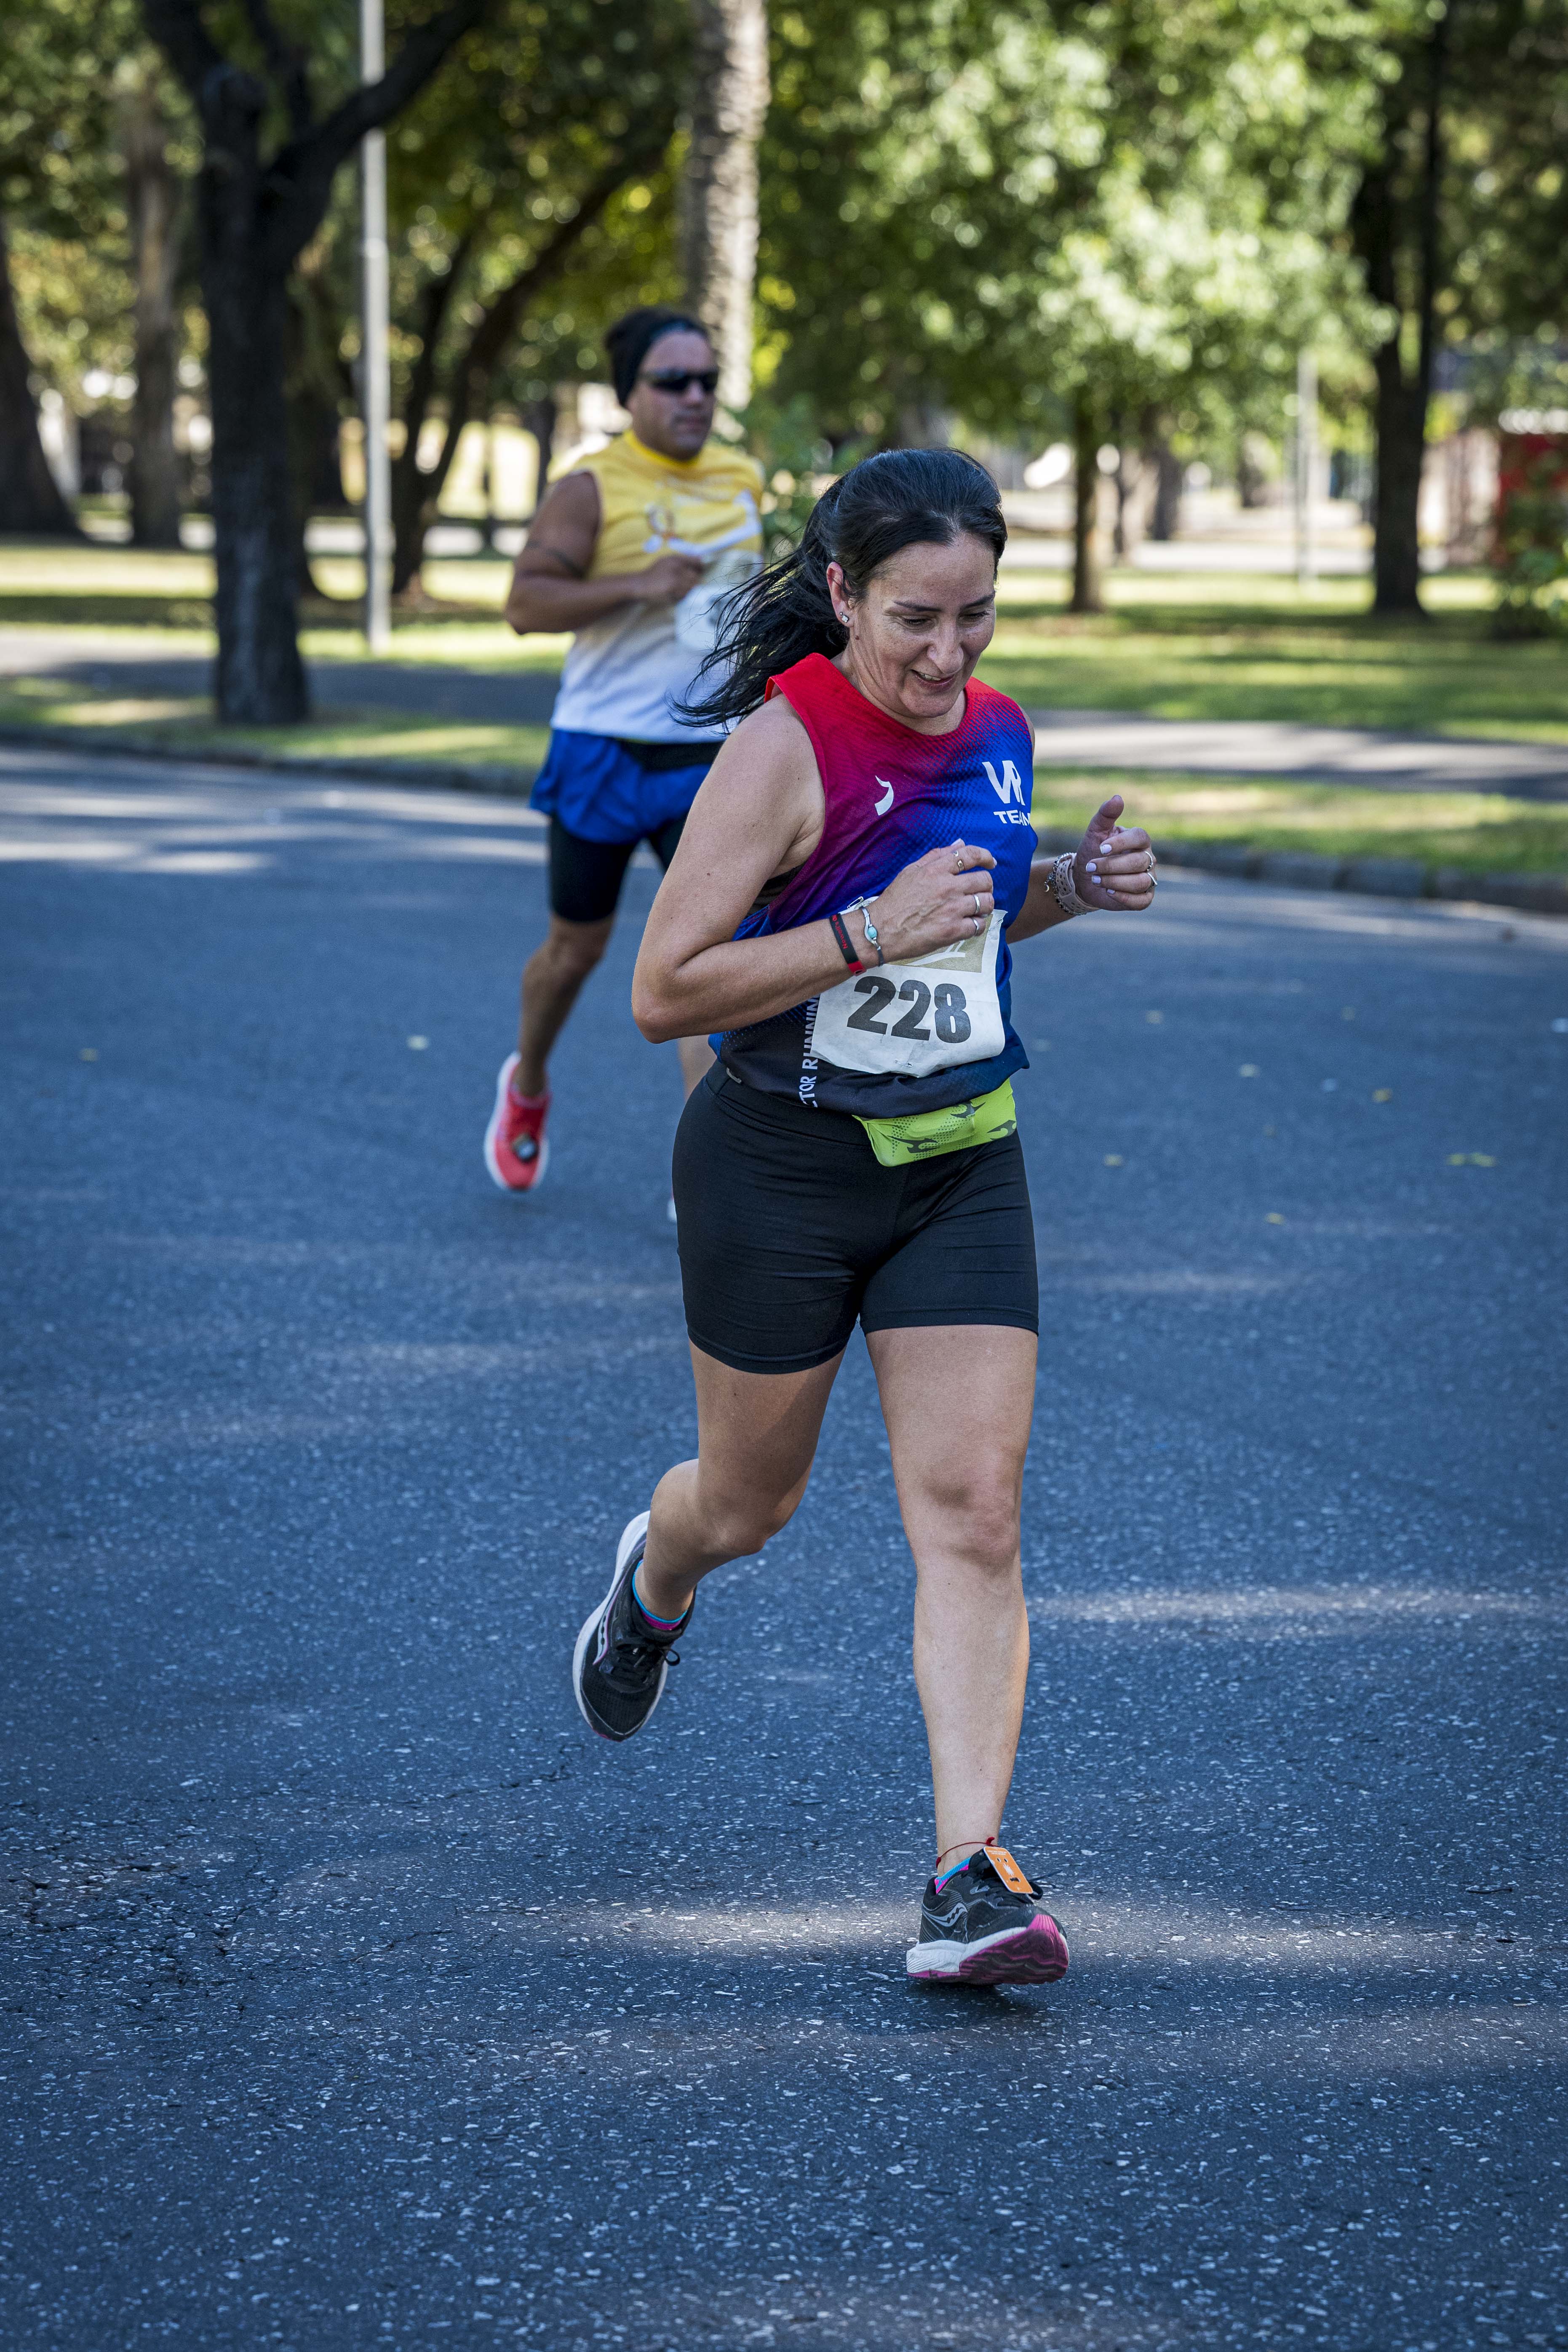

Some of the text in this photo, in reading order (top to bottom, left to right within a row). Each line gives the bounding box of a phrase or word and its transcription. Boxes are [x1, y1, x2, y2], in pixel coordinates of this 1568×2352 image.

[982, 760, 1026, 806] VR
[993, 809, 1031, 826] TEAM
[802, 996, 820, 1070] RNIN
[847, 976, 971, 1044] 228
